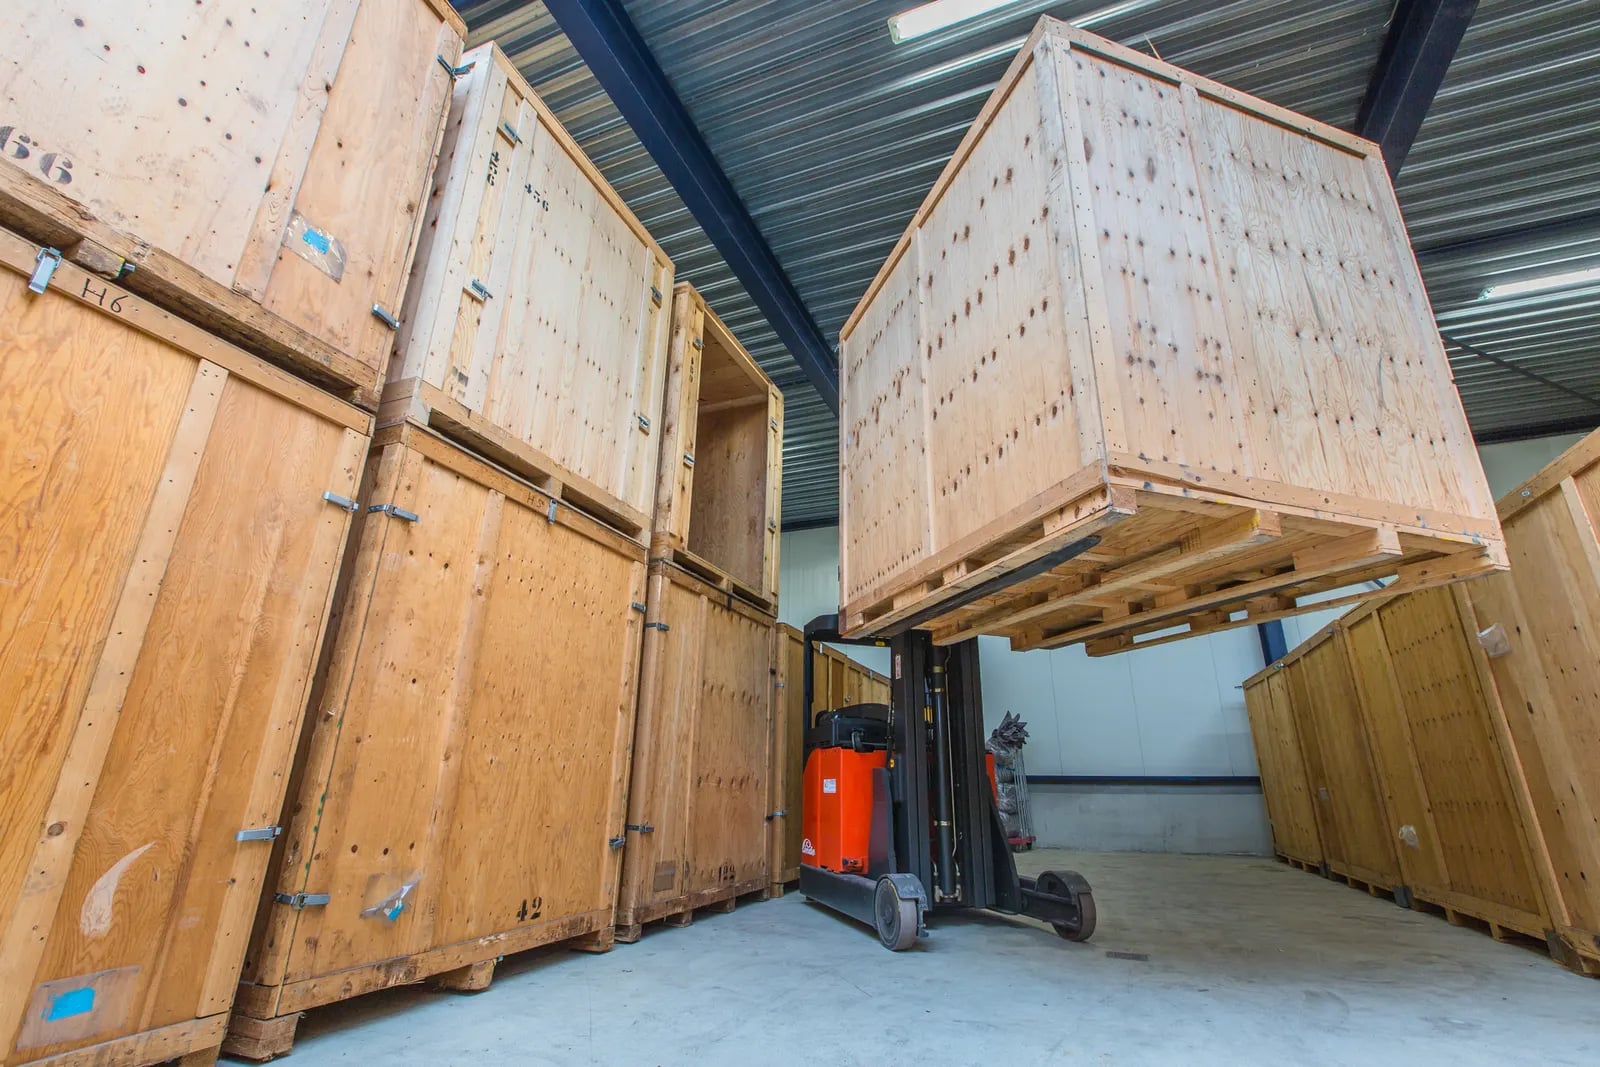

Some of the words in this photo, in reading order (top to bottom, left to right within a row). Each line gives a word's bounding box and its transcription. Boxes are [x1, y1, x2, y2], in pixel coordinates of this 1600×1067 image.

[525, 184, 549, 212] 456
[82, 278, 129, 313] H6
[516, 896, 542, 921] 42
